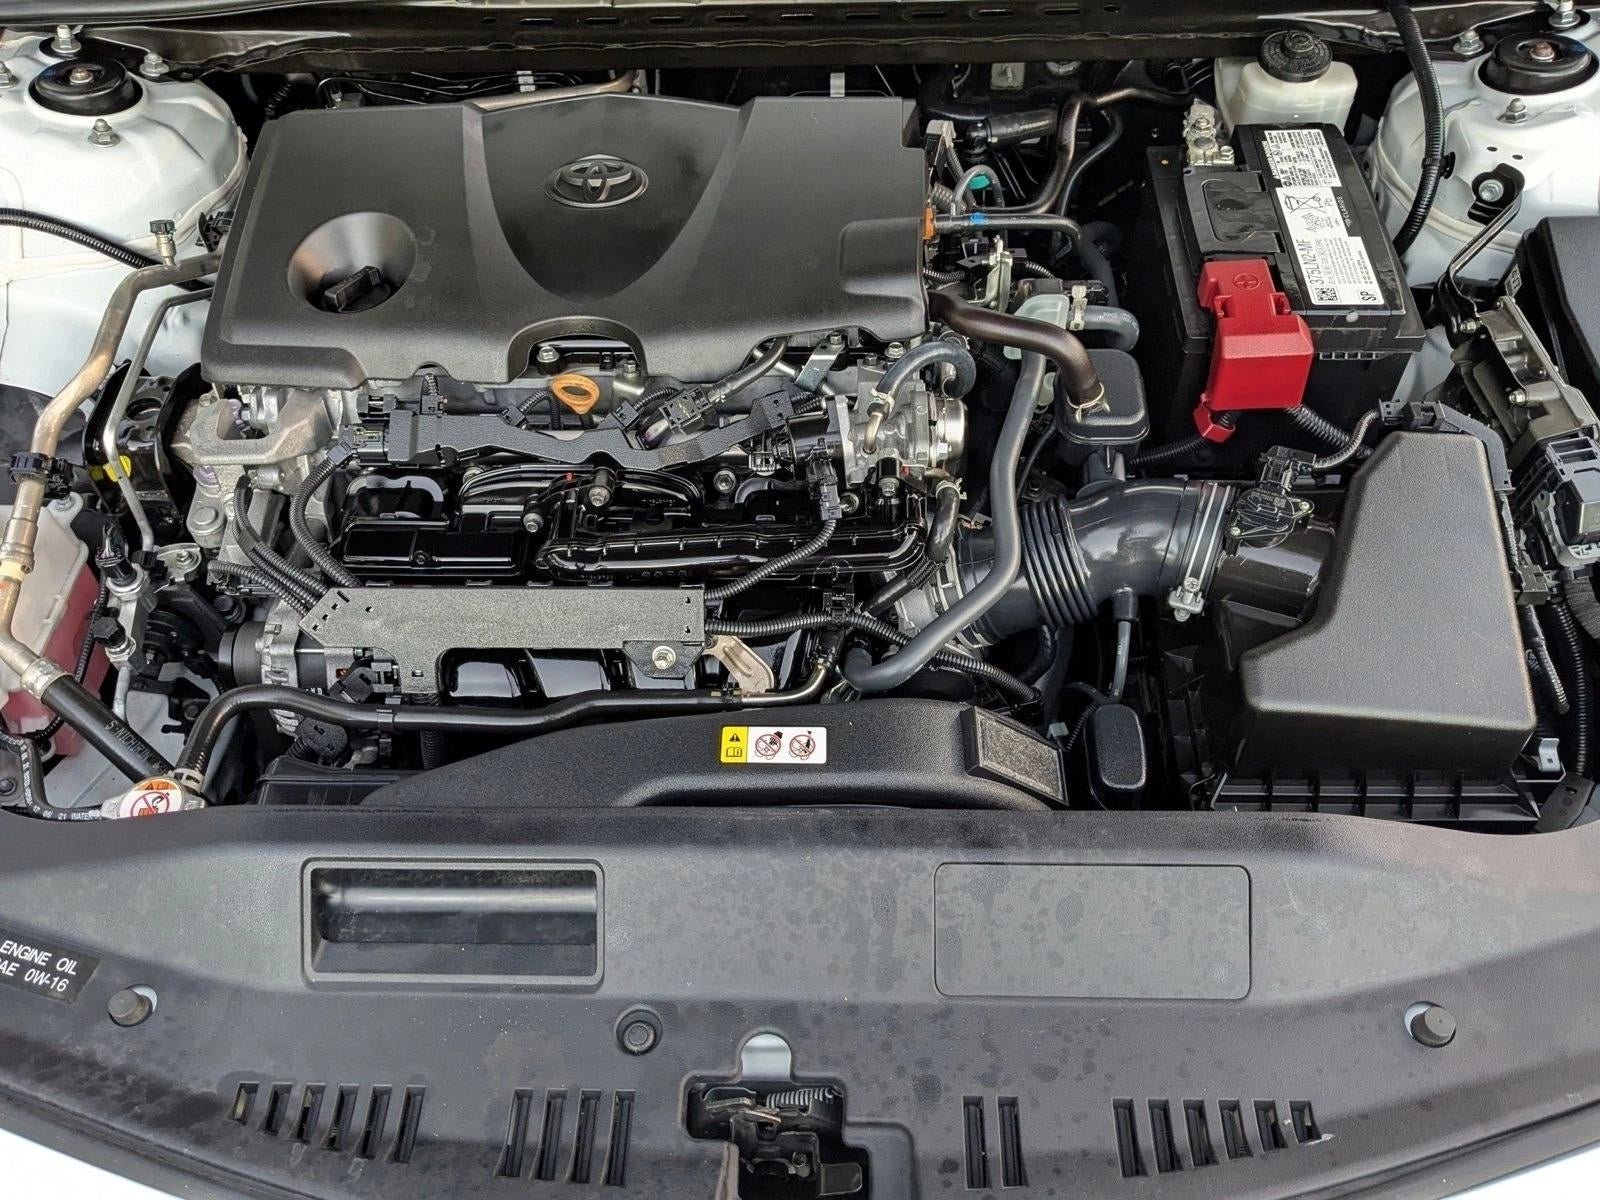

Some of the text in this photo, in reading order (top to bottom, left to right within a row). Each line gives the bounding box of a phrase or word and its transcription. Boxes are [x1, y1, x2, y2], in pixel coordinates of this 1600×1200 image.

[1325, 198, 1334, 206] Pb
[1337, 196, 1349, 218] CLARIOS
[1296, 239, 1324, 284] 375LN2-MF
[1360, 291, 1376, 300] SP
[0, 939, 77, 975] ENGINE OIL
[0, 957, 20, 976] AE
